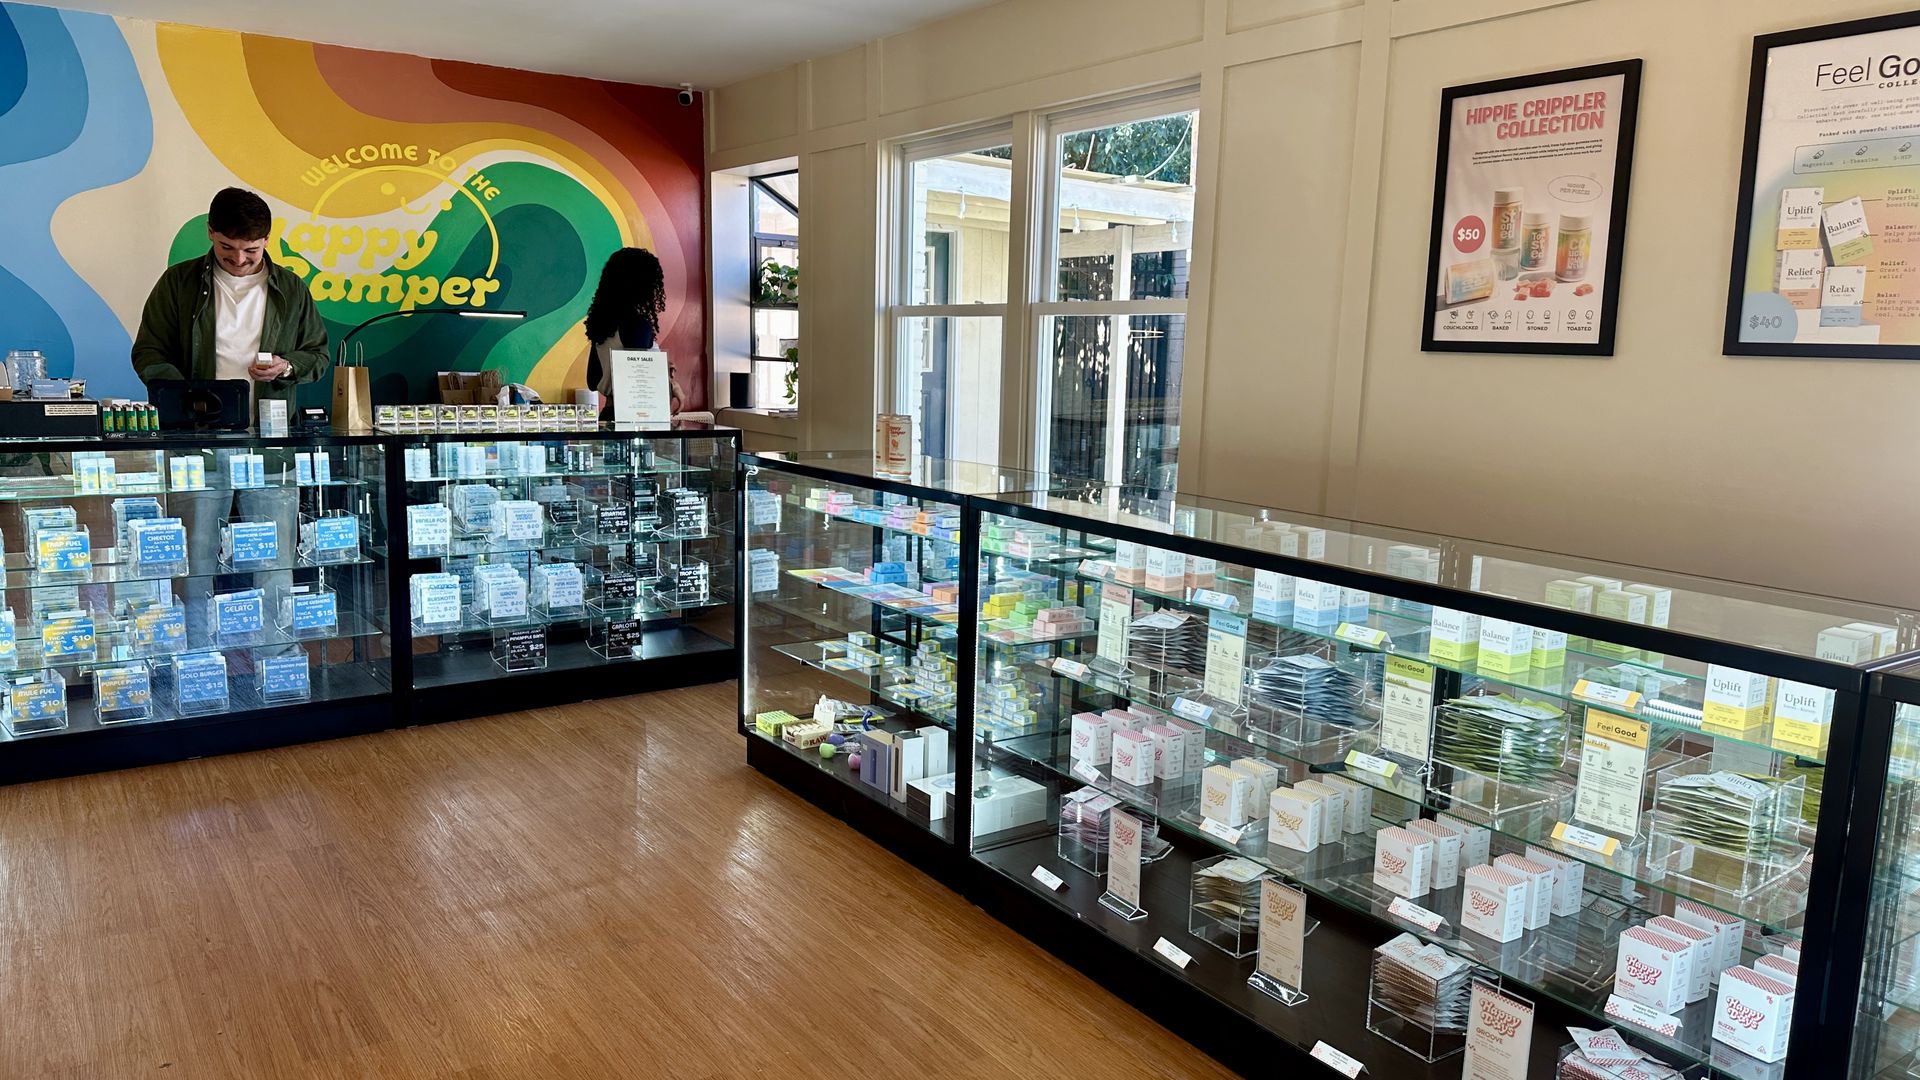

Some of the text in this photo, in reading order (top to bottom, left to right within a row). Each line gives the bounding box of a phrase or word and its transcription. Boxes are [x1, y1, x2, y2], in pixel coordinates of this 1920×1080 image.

[1816, 57, 1871, 87] Feel
[1878, 79, 1920, 89] COLLE
[1466, 91, 1606, 126] HIPPIE CRIPPLER
[1496, 111, 1604, 140] COLLECTION
[301, 143, 501, 201] WELCOME TO THE
[1787, 205, 1814, 216] Uplift
[1827, 217, 1862, 234] Balance
[1457, 227, 1480, 242] $50
[1788, 268, 1813, 276] Relief
[1829, 285, 1856, 293] Relax
[1749, 314, 1783, 330] $40
[1257, 580, 1273, 591] Relax
[1298, 589, 1315, 599] Relax
[224, 604, 253, 612] GELATO
[1226, 622, 1240, 630] Good
[1433, 618, 1460, 631] Balance
[72, 634, 91, 642] $10
[1481, 628, 1510, 642] Balance
[1394, 661, 1425, 674] Feel Good
[206, 682, 223, 690] $15
[1713, 678, 1742, 692] Uplift
[1784, 693, 1816, 708] Uplift
[1597, 721, 1637, 739] Feel Good
[810, 733, 827, 746] RAW
[1276, 808, 1303, 826] Happy
[1277, 817, 1301, 831] Days
[1381, 849, 1407, 868] Happy
[1382, 859, 1403, 874] Days
[1267, 890, 1297, 912] Happy
[1470, 889, 1499, 908] Happy
[1268, 902, 1294, 921] Days
[1471, 899, 1495, 916] Days
[1626, 954, 1662, 978] Happy
[1627, 966, 1656, 985] Days
[1479, 997, 1522, 1028] Happy
[1726, 996, 1765, 1022] Happy
[1480, 1011, 1516, 1038] Days
[1727, 1008, 1759, 1030] Days
[1475, 1026, 1503, 1045] GROOVE
